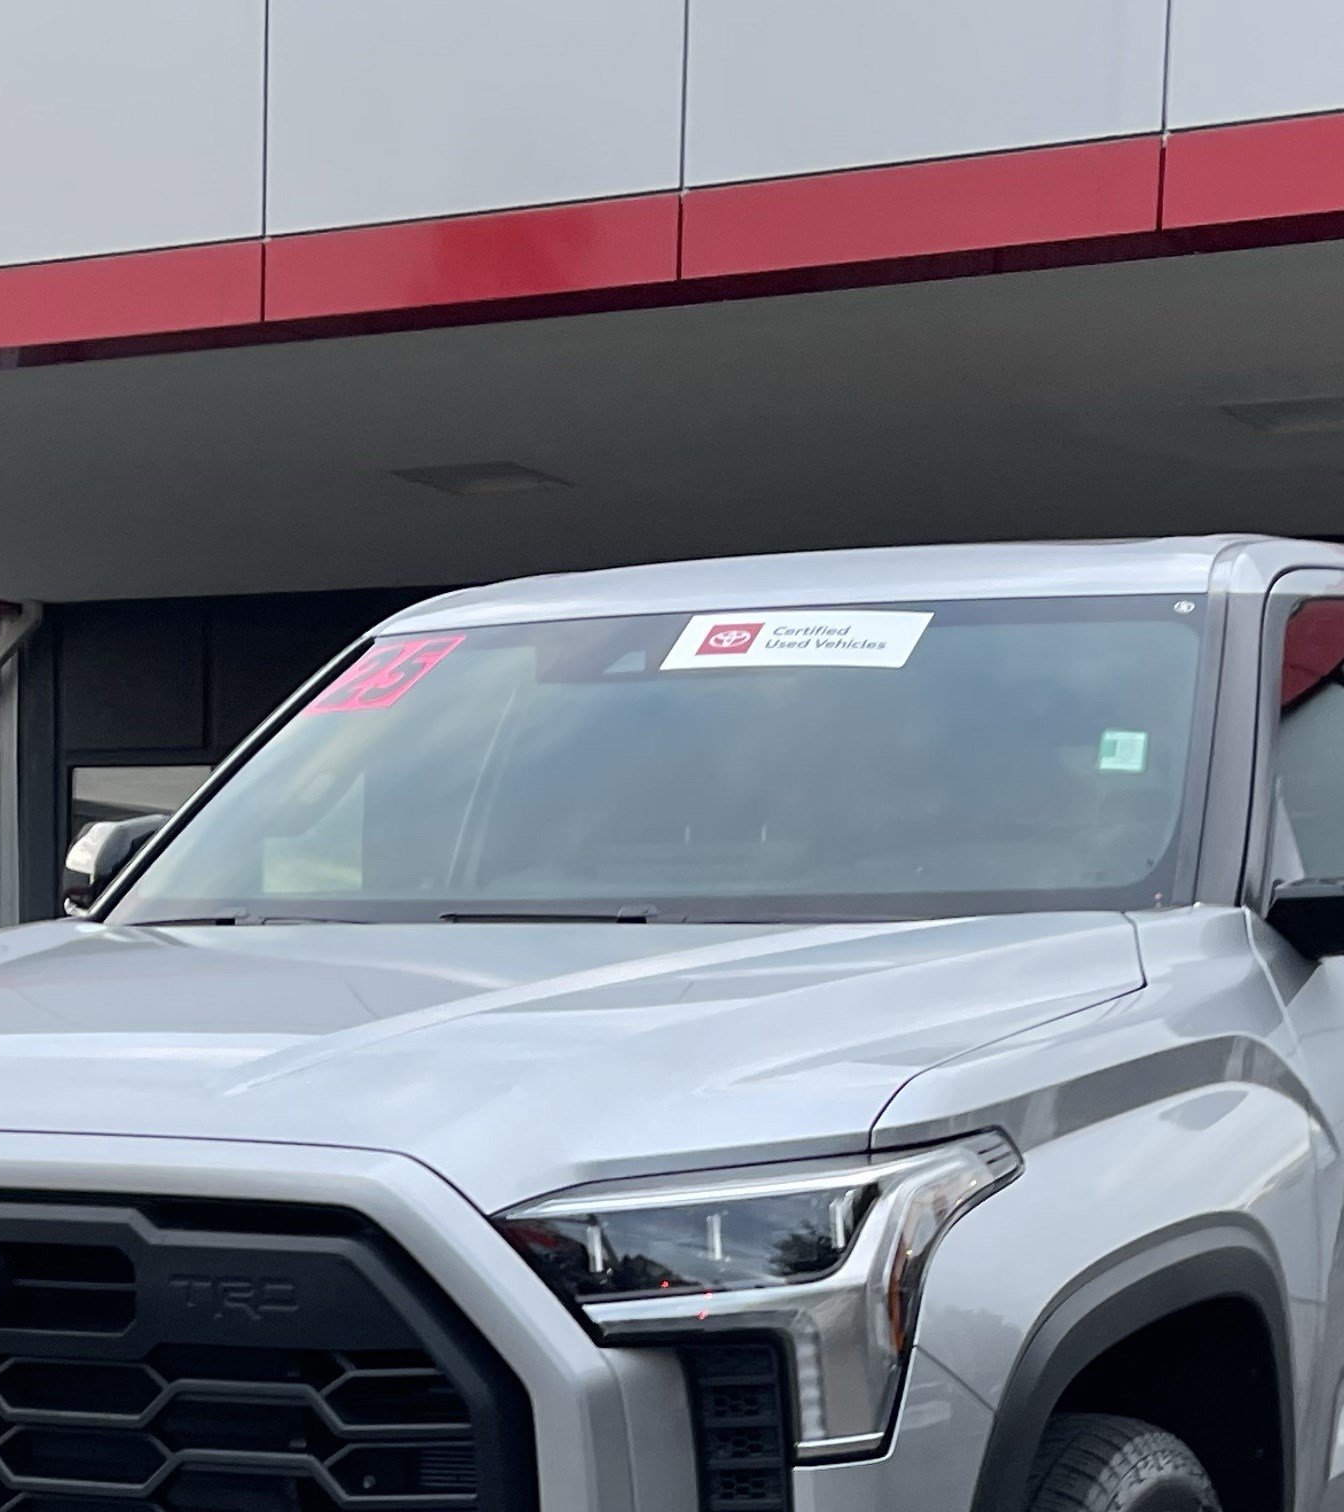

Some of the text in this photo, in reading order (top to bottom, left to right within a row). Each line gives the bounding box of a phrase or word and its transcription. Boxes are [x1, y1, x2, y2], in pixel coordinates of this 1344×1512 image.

[772, 624, 852, 637] Certified
[764, 638, 888, 651] Used Vehicles
